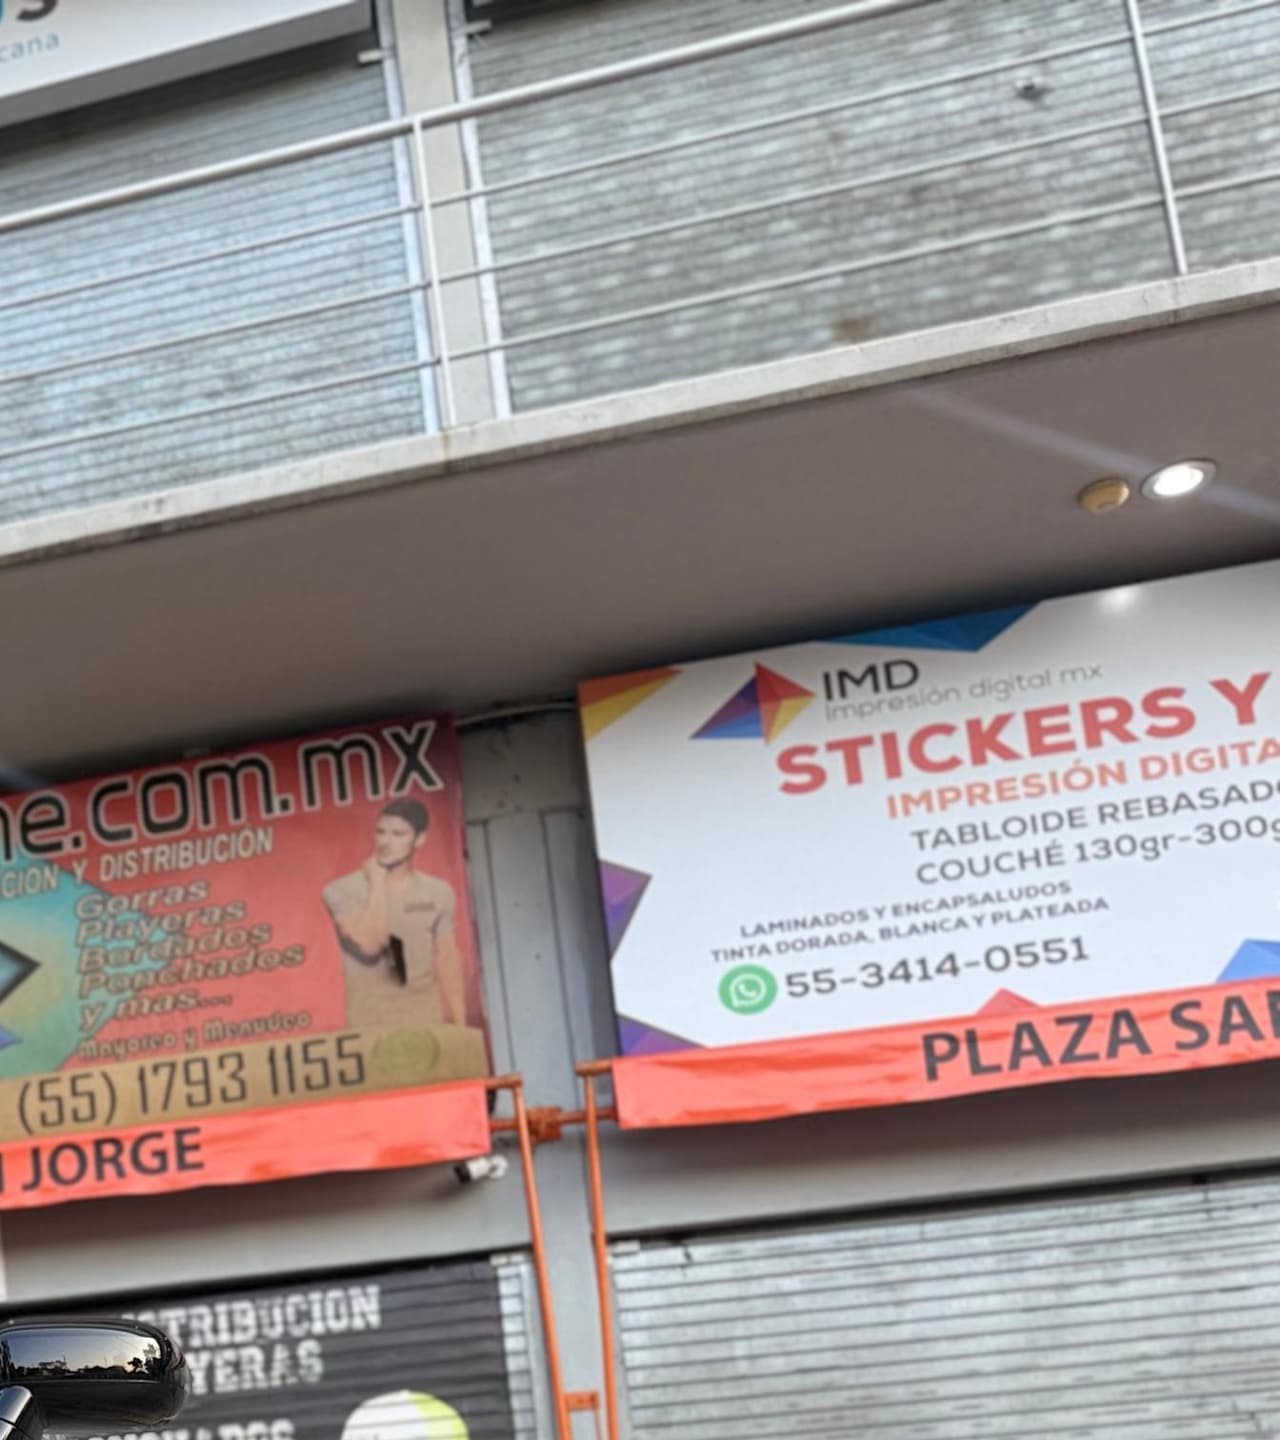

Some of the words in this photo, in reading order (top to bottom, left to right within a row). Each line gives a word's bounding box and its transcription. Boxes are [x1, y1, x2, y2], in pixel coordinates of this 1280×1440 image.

[822, 659, 920, 701] IMD
[968, 670, 1052, 703] digital
[1059, 664, 1104, 683] mx
[775, 685, 1197, 795] STICKERS
[1209, 672, 1271, 726] Y
[886, 759, 1130, 821] IMPRESIÓN
[909, 806, 1088, 852] TABLOIDE
[1098, 779, 1280, 825] REBASAD
[72, 859, 88, 885] Y
[915, 838, 1067, 886] COUCHÉ
[74, 879, 210, 921] Gorras
[77, 900, 247, 950] Playeras
[740, 908, 870, 939] LAMINADOS
[873, 905, 887, 920] Y
[77, 922, 272, 975] Bordados
[711, 943, 772, 964] TINTA
[879, 916, 969, 942] BLANCA
[972, 914, 989, 930] Y
[990, 897, 1110, 926] PLATEADA
[78, 943, 307, 999] Ponchados
[785, 935, 1090, 999] 55-3414-0551
[921, 1008, 1152, 1083] PLAZA
[18, 1071, 117, 1135] (55)
[137, 1051, 247, 1115] 1793
[268, 1034, 366, 1096] 1155
[21, 1126, 205, 1191] JORGE
[121, 1285, 381, 1349] TRIBUCION
[187, 1339, 324, 1395] YERAS
